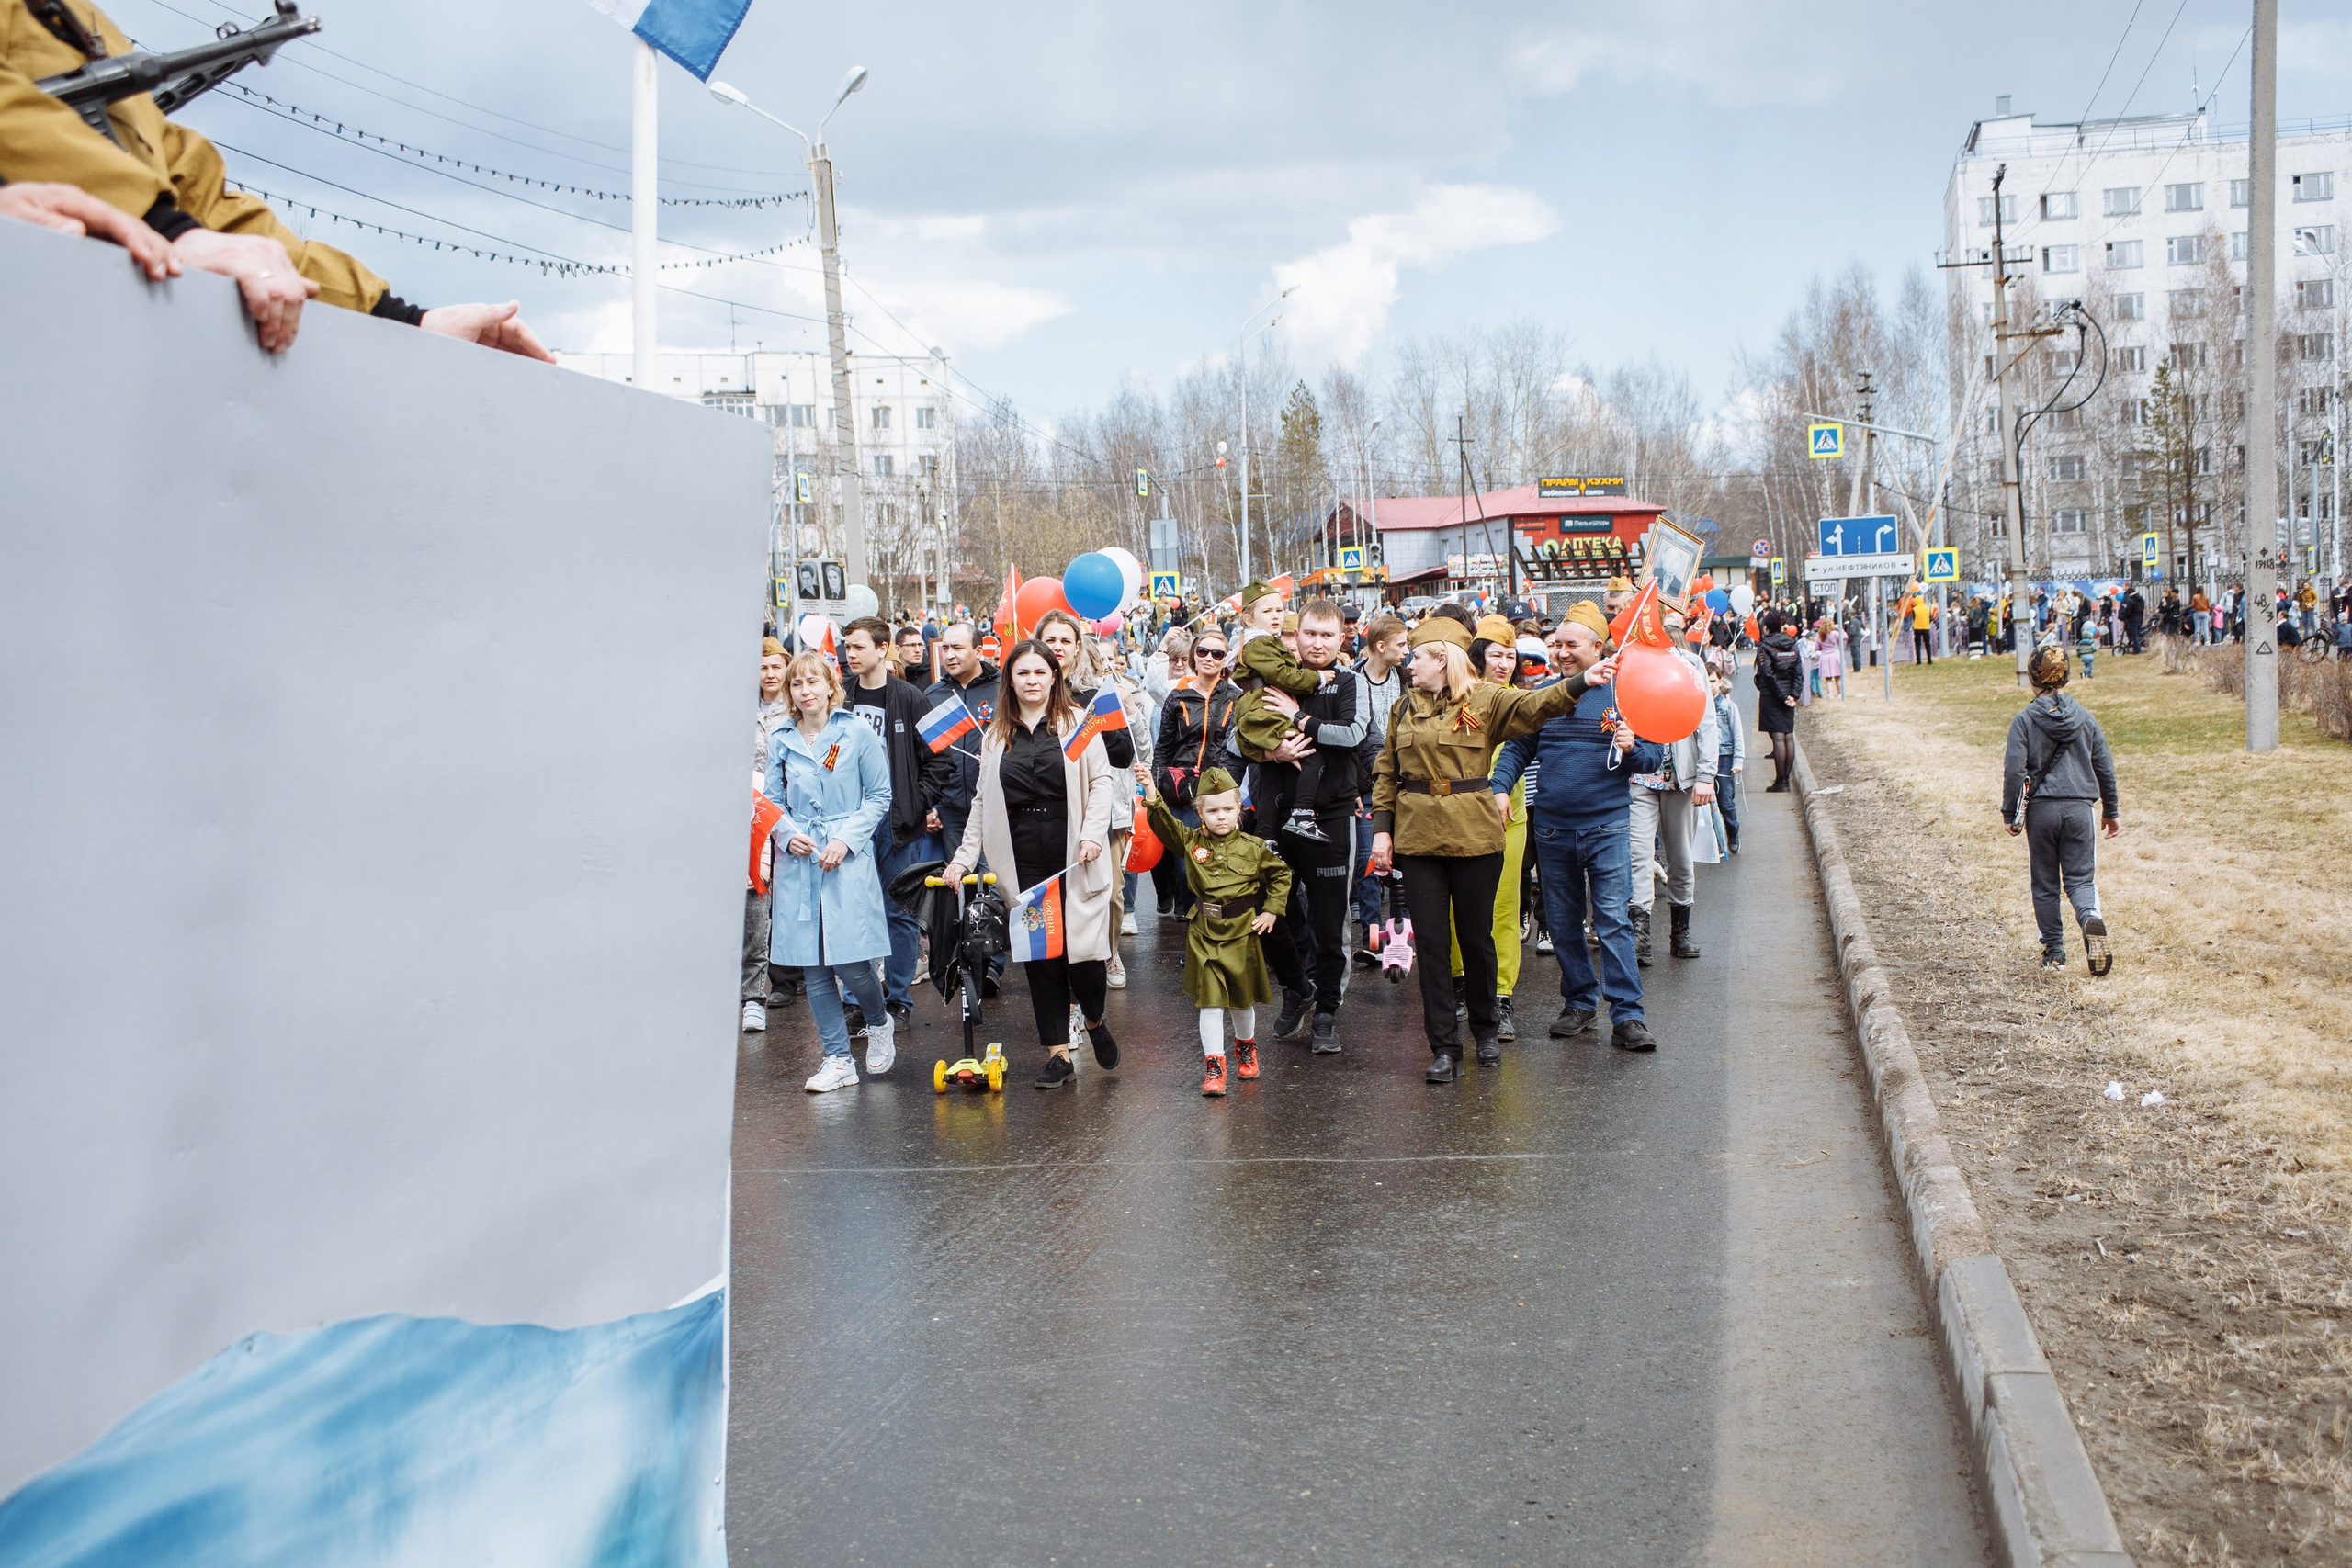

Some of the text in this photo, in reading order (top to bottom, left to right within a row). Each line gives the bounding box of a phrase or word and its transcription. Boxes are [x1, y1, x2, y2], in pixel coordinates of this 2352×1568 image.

[1541, 477, 1623, 487] ПРАЙМ КУХНИ
[1561, 536, 1622, 550] АПТЕКА
[1823, 561, 1897, 574] ул.НЕФТЯНИКОВ
[1814, 582, 1836, 593] СТОП
[1316, 865, 1346, 877] PUMA
